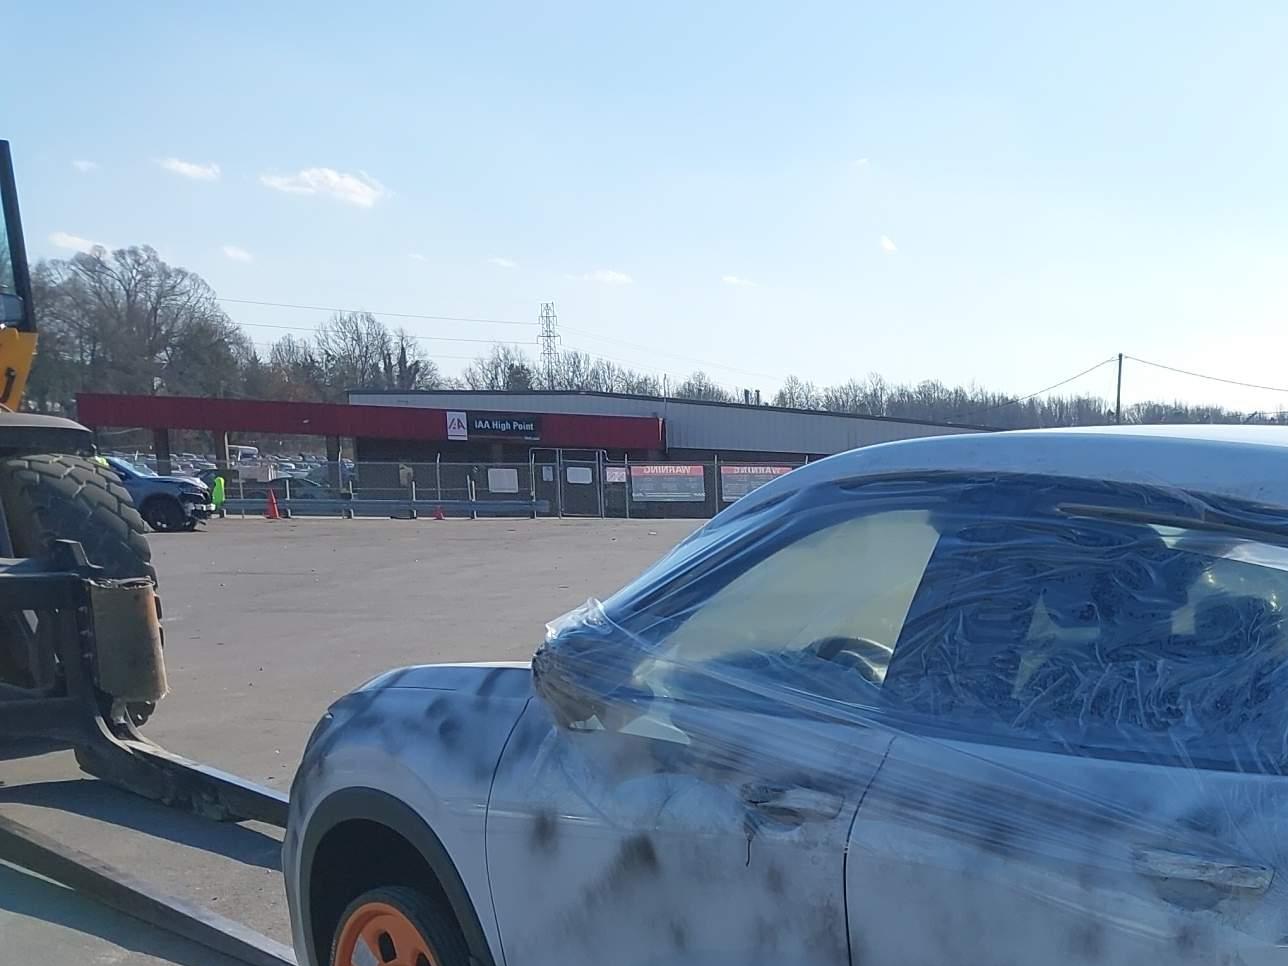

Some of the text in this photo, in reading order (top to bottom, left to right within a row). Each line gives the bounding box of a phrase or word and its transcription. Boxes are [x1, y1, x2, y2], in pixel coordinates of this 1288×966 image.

[474, 419, 534, 431] IAA High Point
